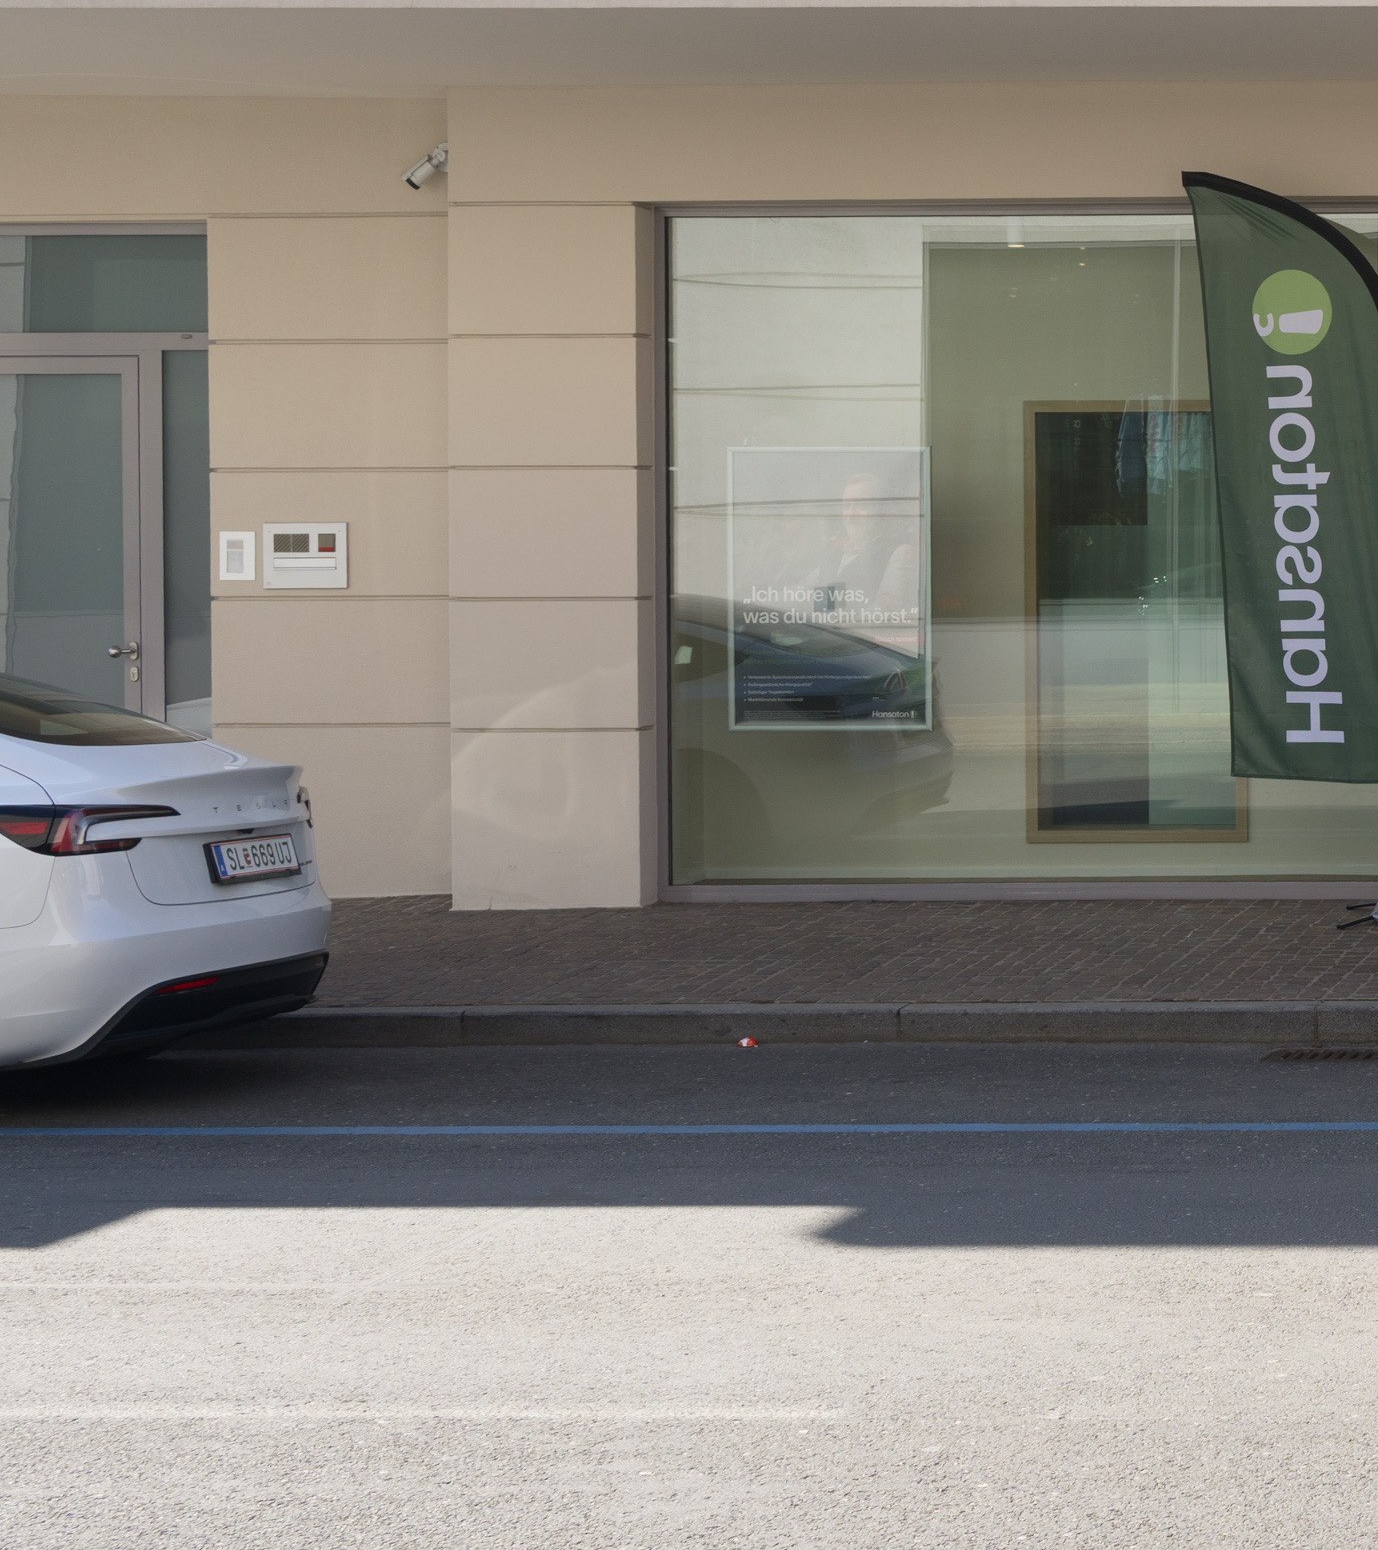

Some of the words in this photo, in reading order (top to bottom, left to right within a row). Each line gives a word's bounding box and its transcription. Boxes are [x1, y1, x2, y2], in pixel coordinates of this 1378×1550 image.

[783, 586, 824, 602] höre
[828, 589, 869, 604] was,
[743, 611, 779, 624] was
[783, 608, 807, 624] du
[811, 607, 855, 624] nicht
[872, 710, 910, 718] Hansaton
[226, 847, 245, 870] SL
[251, 843, 276, 867] 669
[275, 841, 292, 865] UJ
